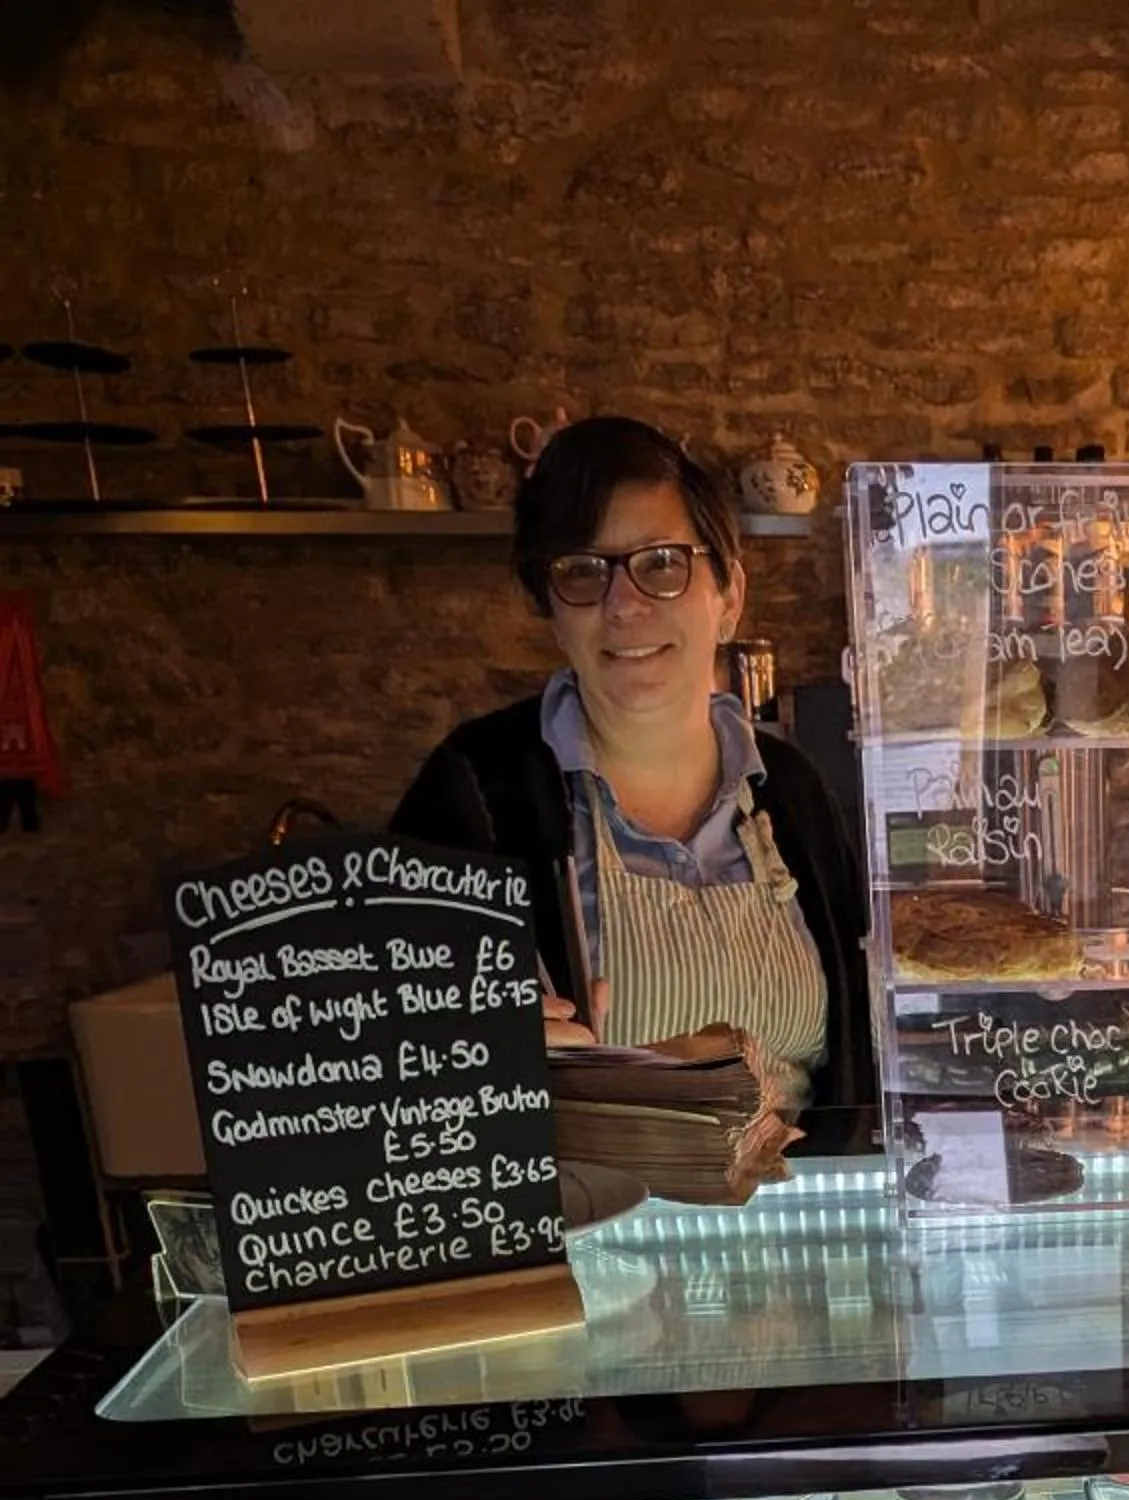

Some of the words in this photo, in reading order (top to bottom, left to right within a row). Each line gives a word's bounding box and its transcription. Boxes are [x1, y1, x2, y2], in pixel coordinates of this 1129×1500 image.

[893, 482, 990, 547] Plain
[1002, 501, 1044, 534] or
[1041, 621, 1129, 671] Tea)
[927, 815, 1042, 867] Raisin
[176, 857, 332, 927] Cheeses
[367, 847, 531, 906] Charcuterie
[190, 946, 275, 999] Royal
[278, 944, 378, 976] Basset
[387, 938, 454, 971] Blue
[476, 936, 515, 974] £6
[202, 1004, 266, 1037] Isle
[271, 995, 303, 1032] of
[397, 986, 462, 1014] Blue
[470, 975, 539, 1014] £6.75
[399, 1040, 489, 1083] £4.50
[932, 1011, 1042, 1066] Triple
[993, 1055, 1101, 1107] Cookie
[212, 1103, 381, 1146] Godminster
[382, 1097, 479, 1133] Vintage
[480, 1084, 550, 1116] Bruton
[384, 1129, 477, 1164] £5.50
[231, 1184, 348, 1225] Quickes
[491, 1154, 558, 1190] £3.65
[238, 1219, 376, 1267] Quince
[395, 1198, 505, 1238] £3.50
